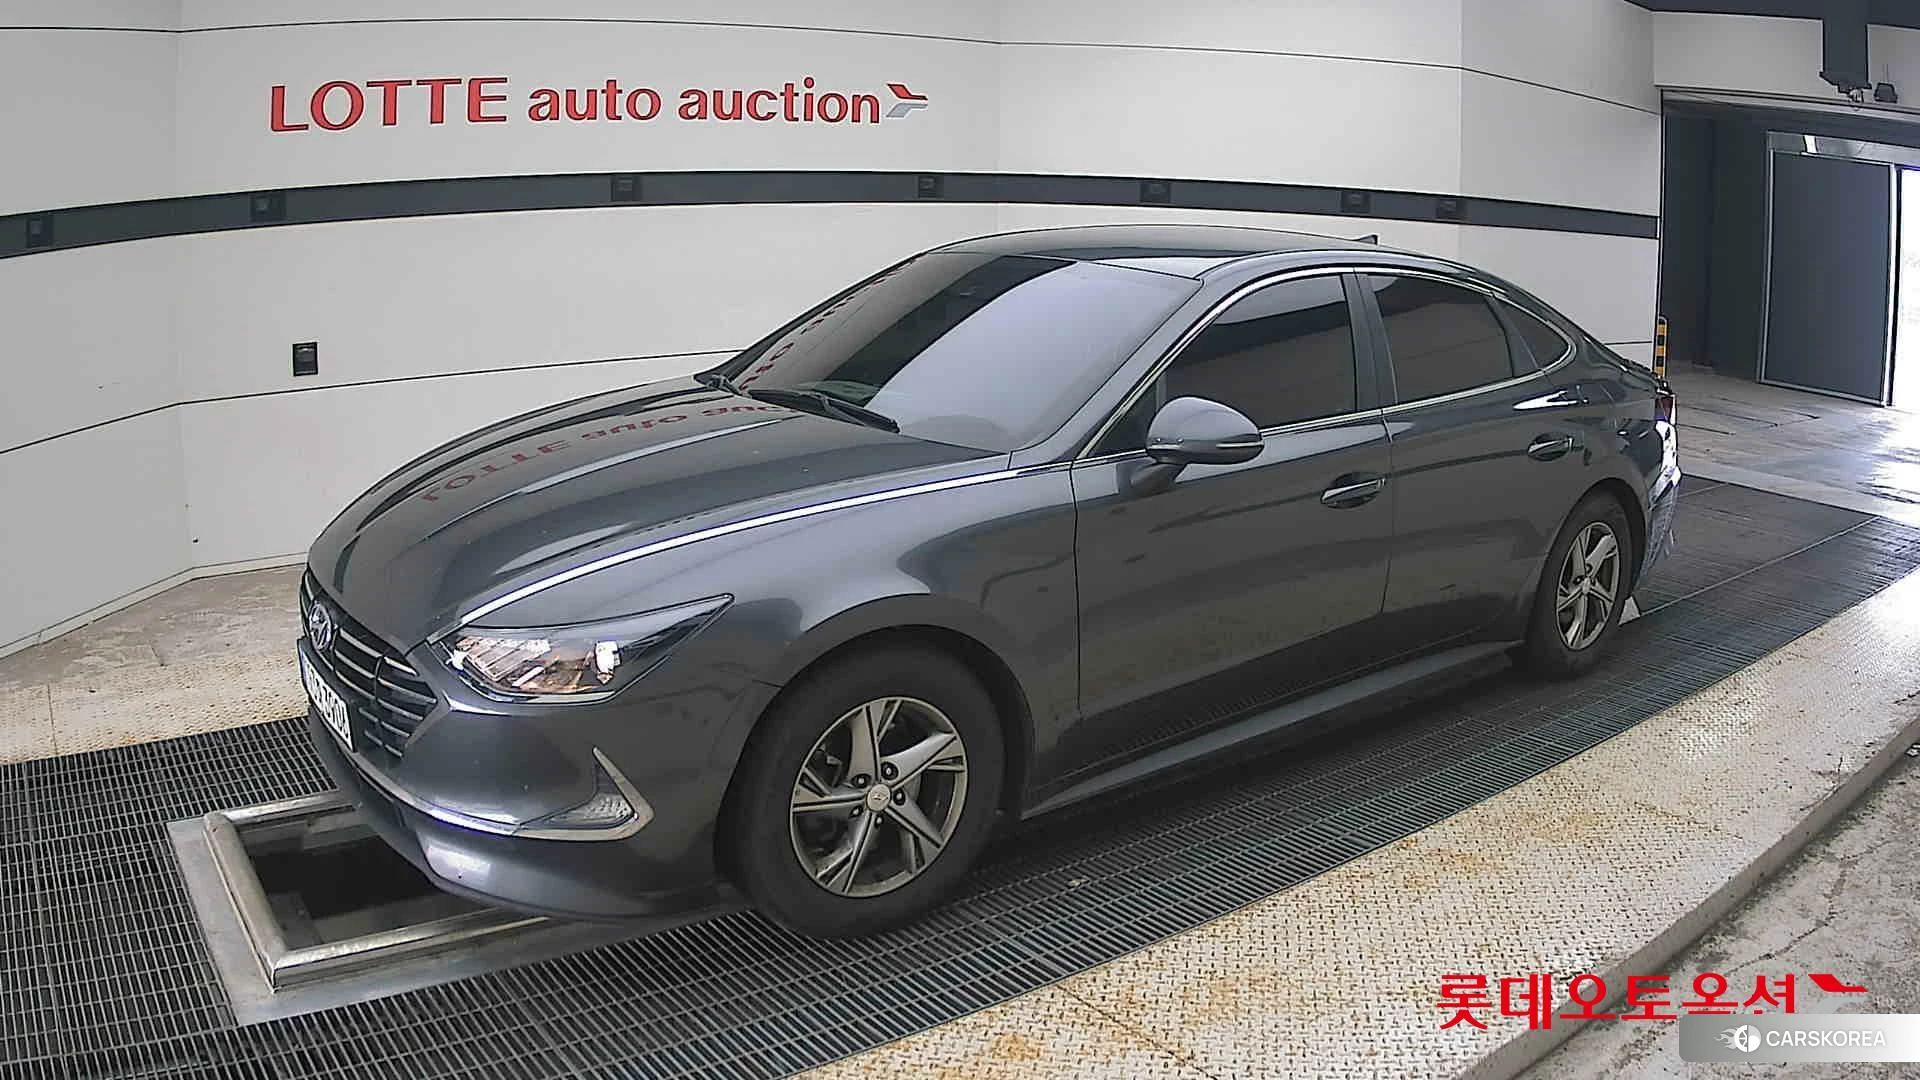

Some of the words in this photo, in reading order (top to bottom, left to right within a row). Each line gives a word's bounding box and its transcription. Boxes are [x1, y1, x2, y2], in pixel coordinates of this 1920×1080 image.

[270, 77, 507, 132] LOTTE
[527, 79, 662, 122] auto
[678, 76, 881, 124] auction
